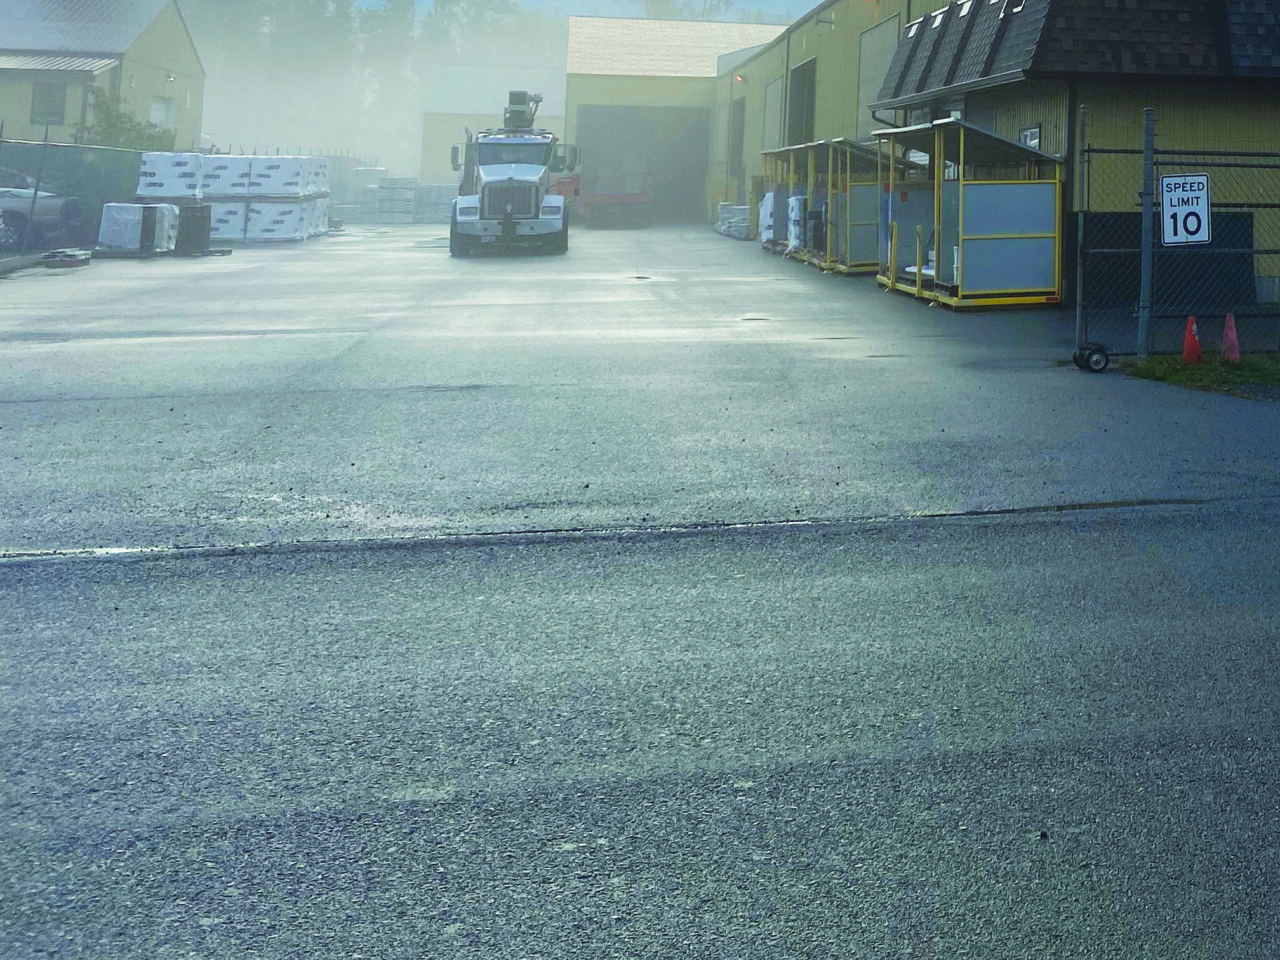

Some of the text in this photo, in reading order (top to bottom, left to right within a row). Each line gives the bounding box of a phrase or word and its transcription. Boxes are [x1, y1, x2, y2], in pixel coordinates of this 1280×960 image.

[1165, 182, 1205, 193] SPEED
[1170, 196, 1201, 208] LIMIT
[1170, 211, 1202, 237] 10
